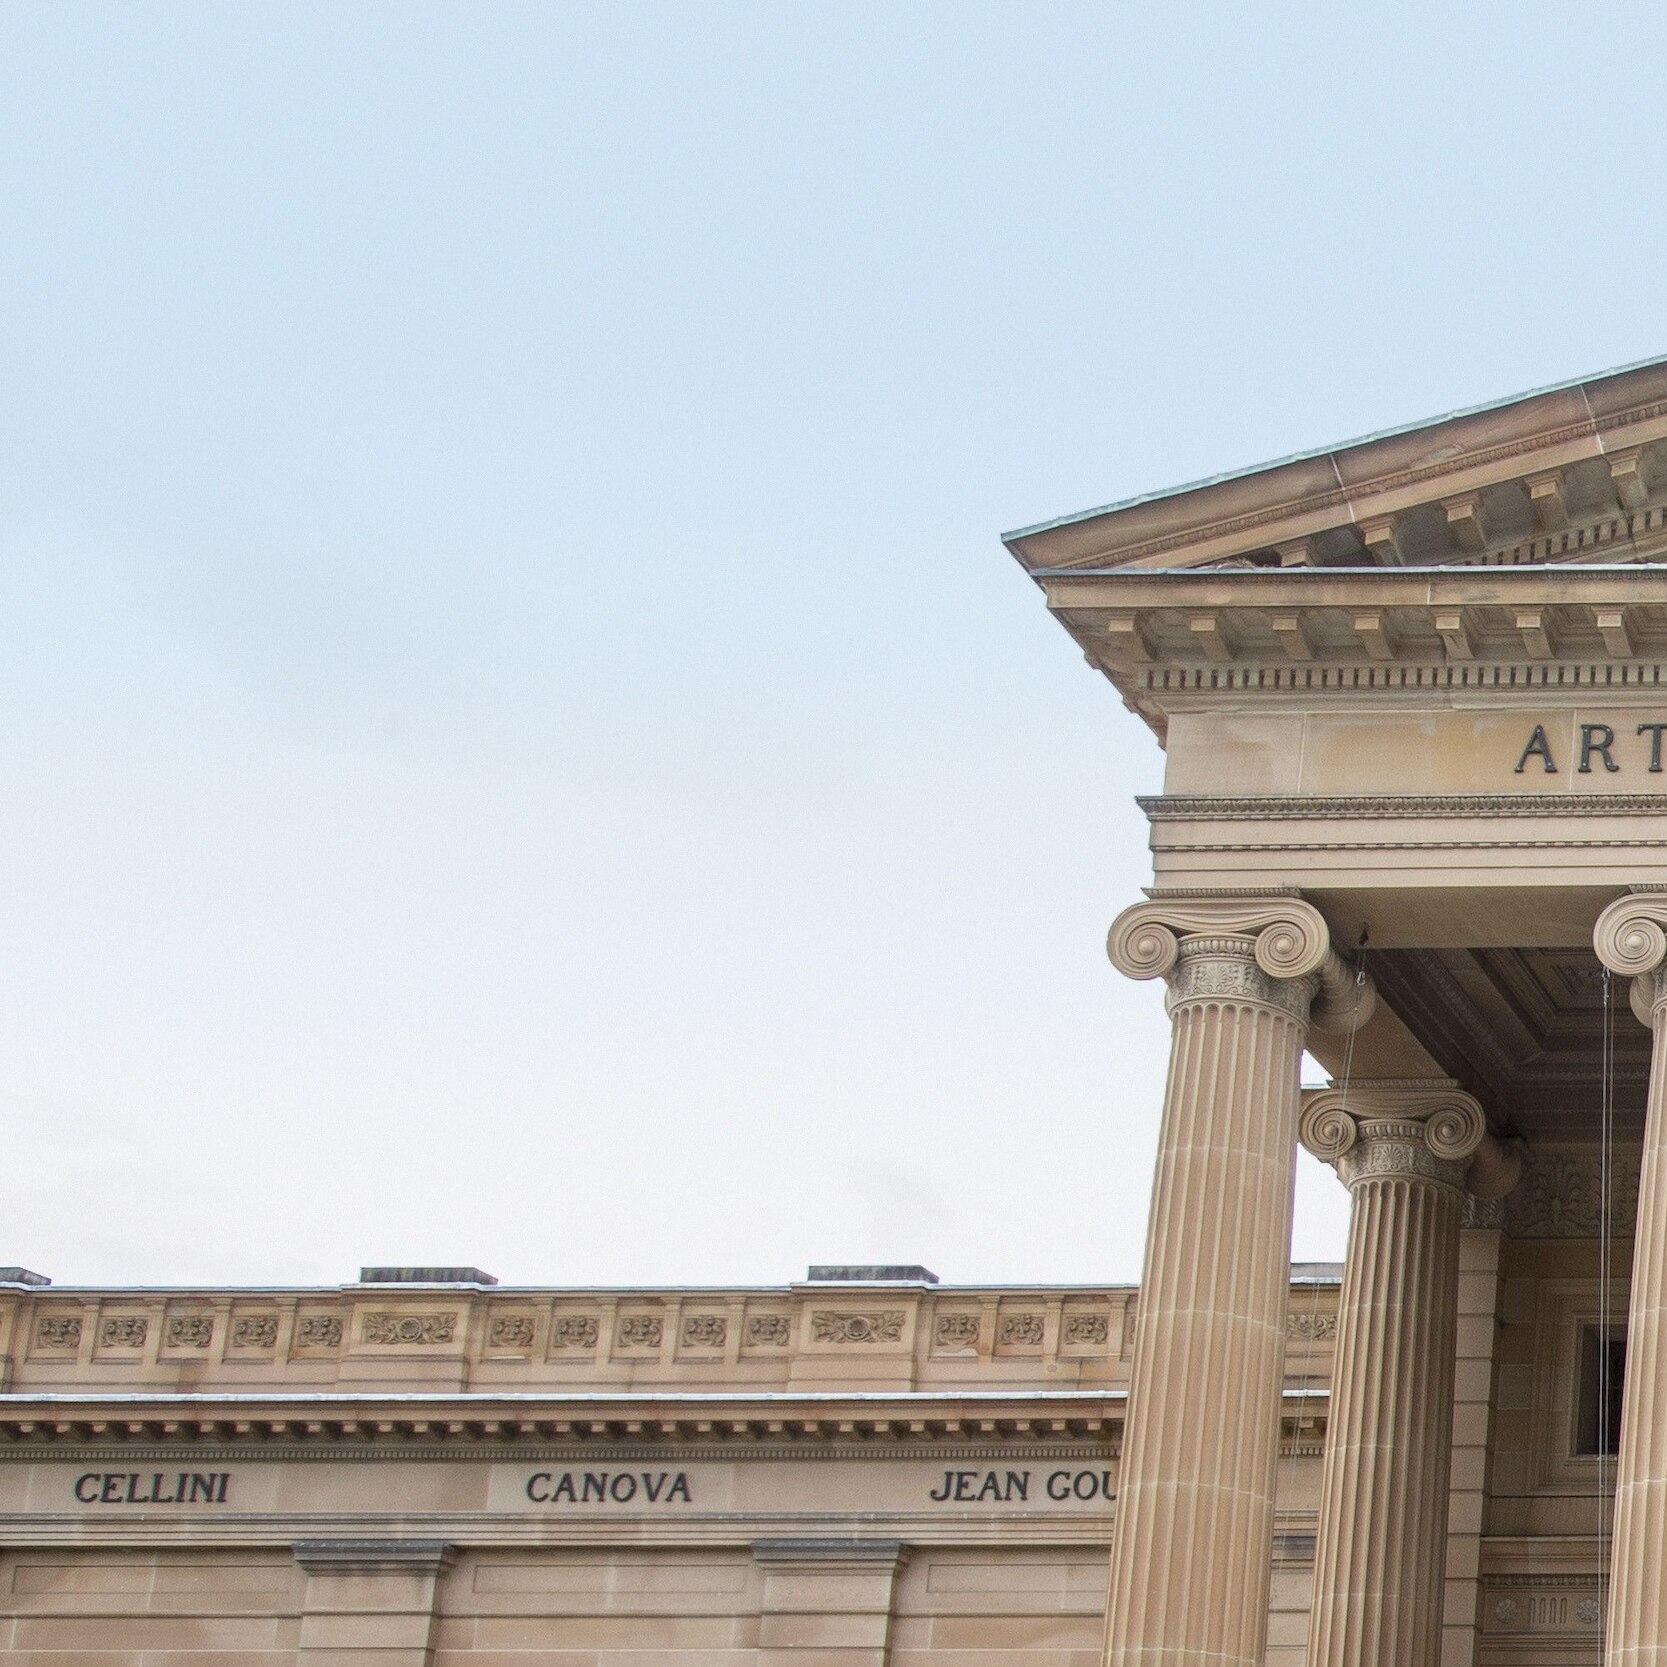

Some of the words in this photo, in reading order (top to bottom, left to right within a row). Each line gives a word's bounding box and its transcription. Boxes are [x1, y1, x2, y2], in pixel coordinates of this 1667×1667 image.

[74, 1472, 231, 1504] CELLINI
[526, 1472, 692, 1503] CANOVA
[930, 1471, 1031, 1501] JEAN
